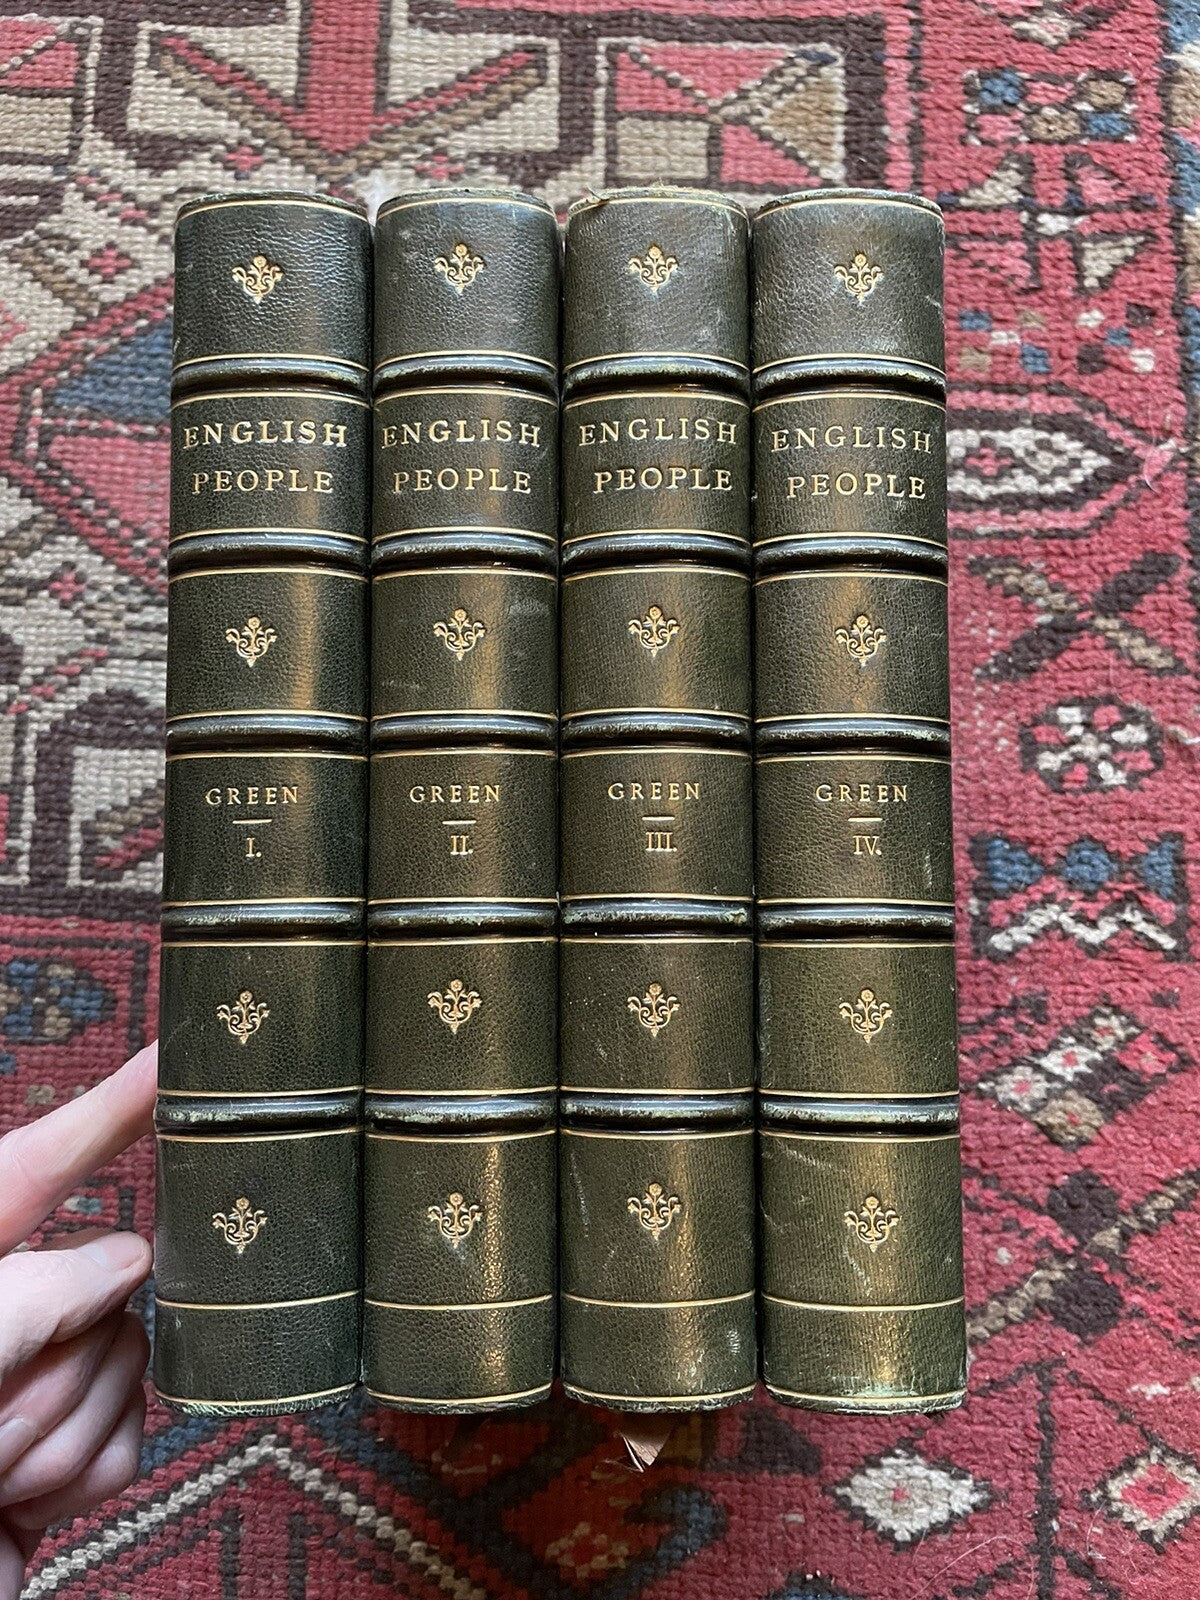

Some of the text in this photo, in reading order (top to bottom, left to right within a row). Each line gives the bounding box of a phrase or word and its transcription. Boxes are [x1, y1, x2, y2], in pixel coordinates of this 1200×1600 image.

[183, 420, 347, 449] ENGLISH
[381, 419, 541, 449] ENGLISH
[579, 418, 737, 447] ENGLISH
[771, 426, 932, 454] ENGLISH
[192, 469, 334, 495] PEOPLE
[392, 468, 531, 495] PEOPLE
[593, 467, 732, 494] PEOPLE
[787, 472, 925, 499] PEOPLE
[205, 786, 299, 806] GREEN
[409, 784, 501, 804] GREEN
[608, 782, 700, 801] GREEN
[815, 784, 908, 803] GREEN
[245, 837, 261, 858] I.
[450, 835, 473, 856] II.
[645, 831, 677, 853] III.
[853, 835, 882, 856] IV.
